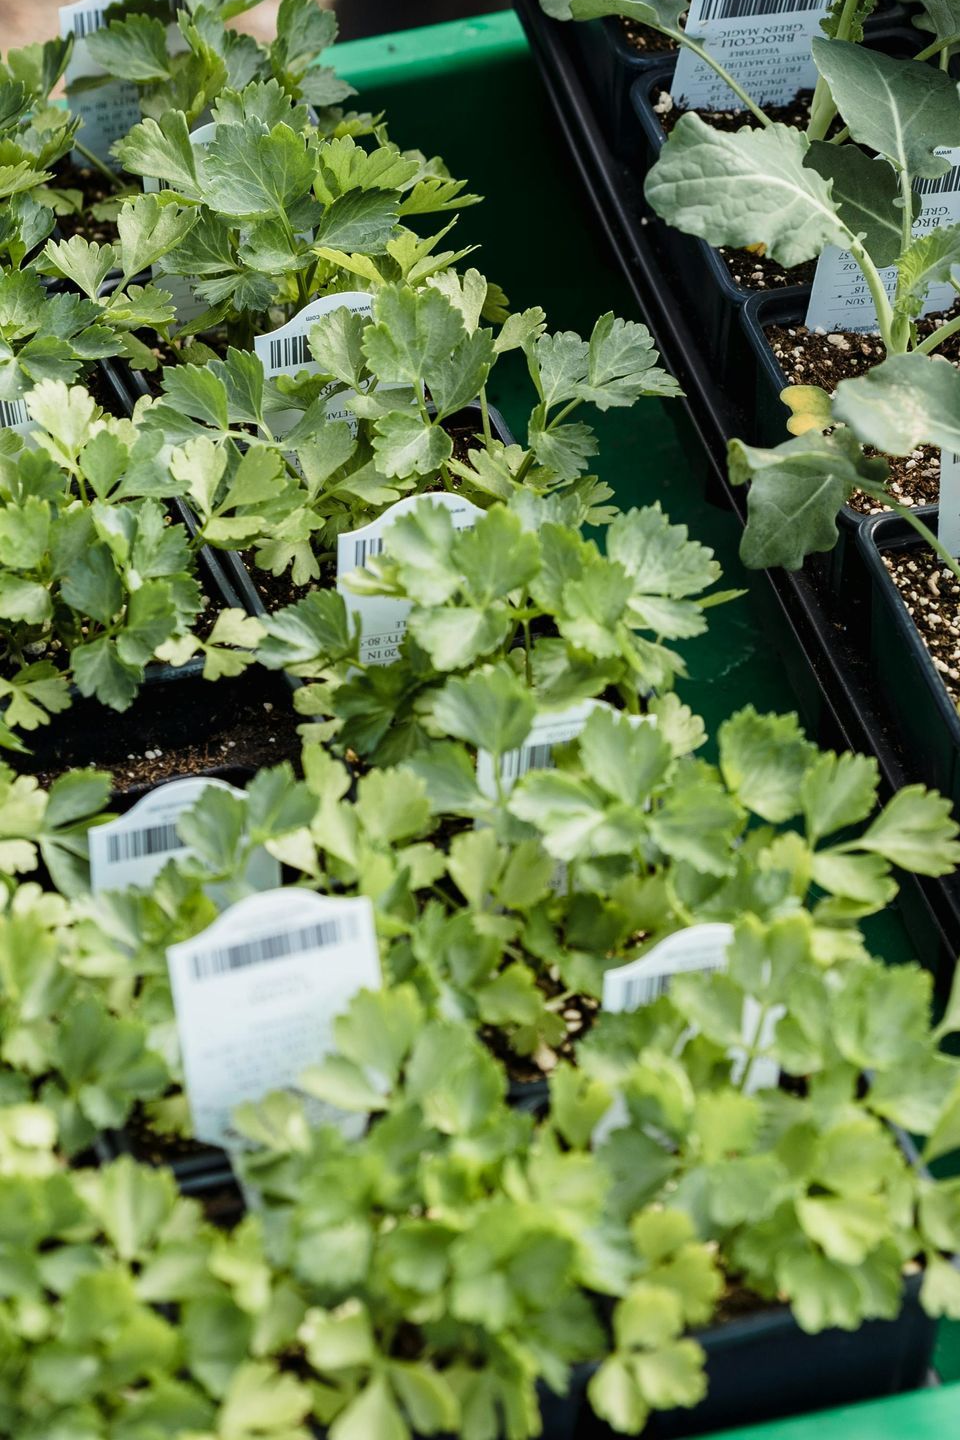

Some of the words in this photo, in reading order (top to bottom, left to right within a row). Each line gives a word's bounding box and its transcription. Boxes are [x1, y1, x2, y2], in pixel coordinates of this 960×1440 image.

[720, 32, 795, 47] BROCCOLI
[728, 46, 779, 58] VEGETABLE
[784, 53, 810, 62] DAYS
[720, 58, 763, 69] MATURI
[771, 65, 801, 74] FRUIT
[741, 77, 786, 88] SPACING
[748, 88, 782, 97] HEIGH
[842, 262, 856, 270] OZ
[844, 297, 865, 305] SUN
